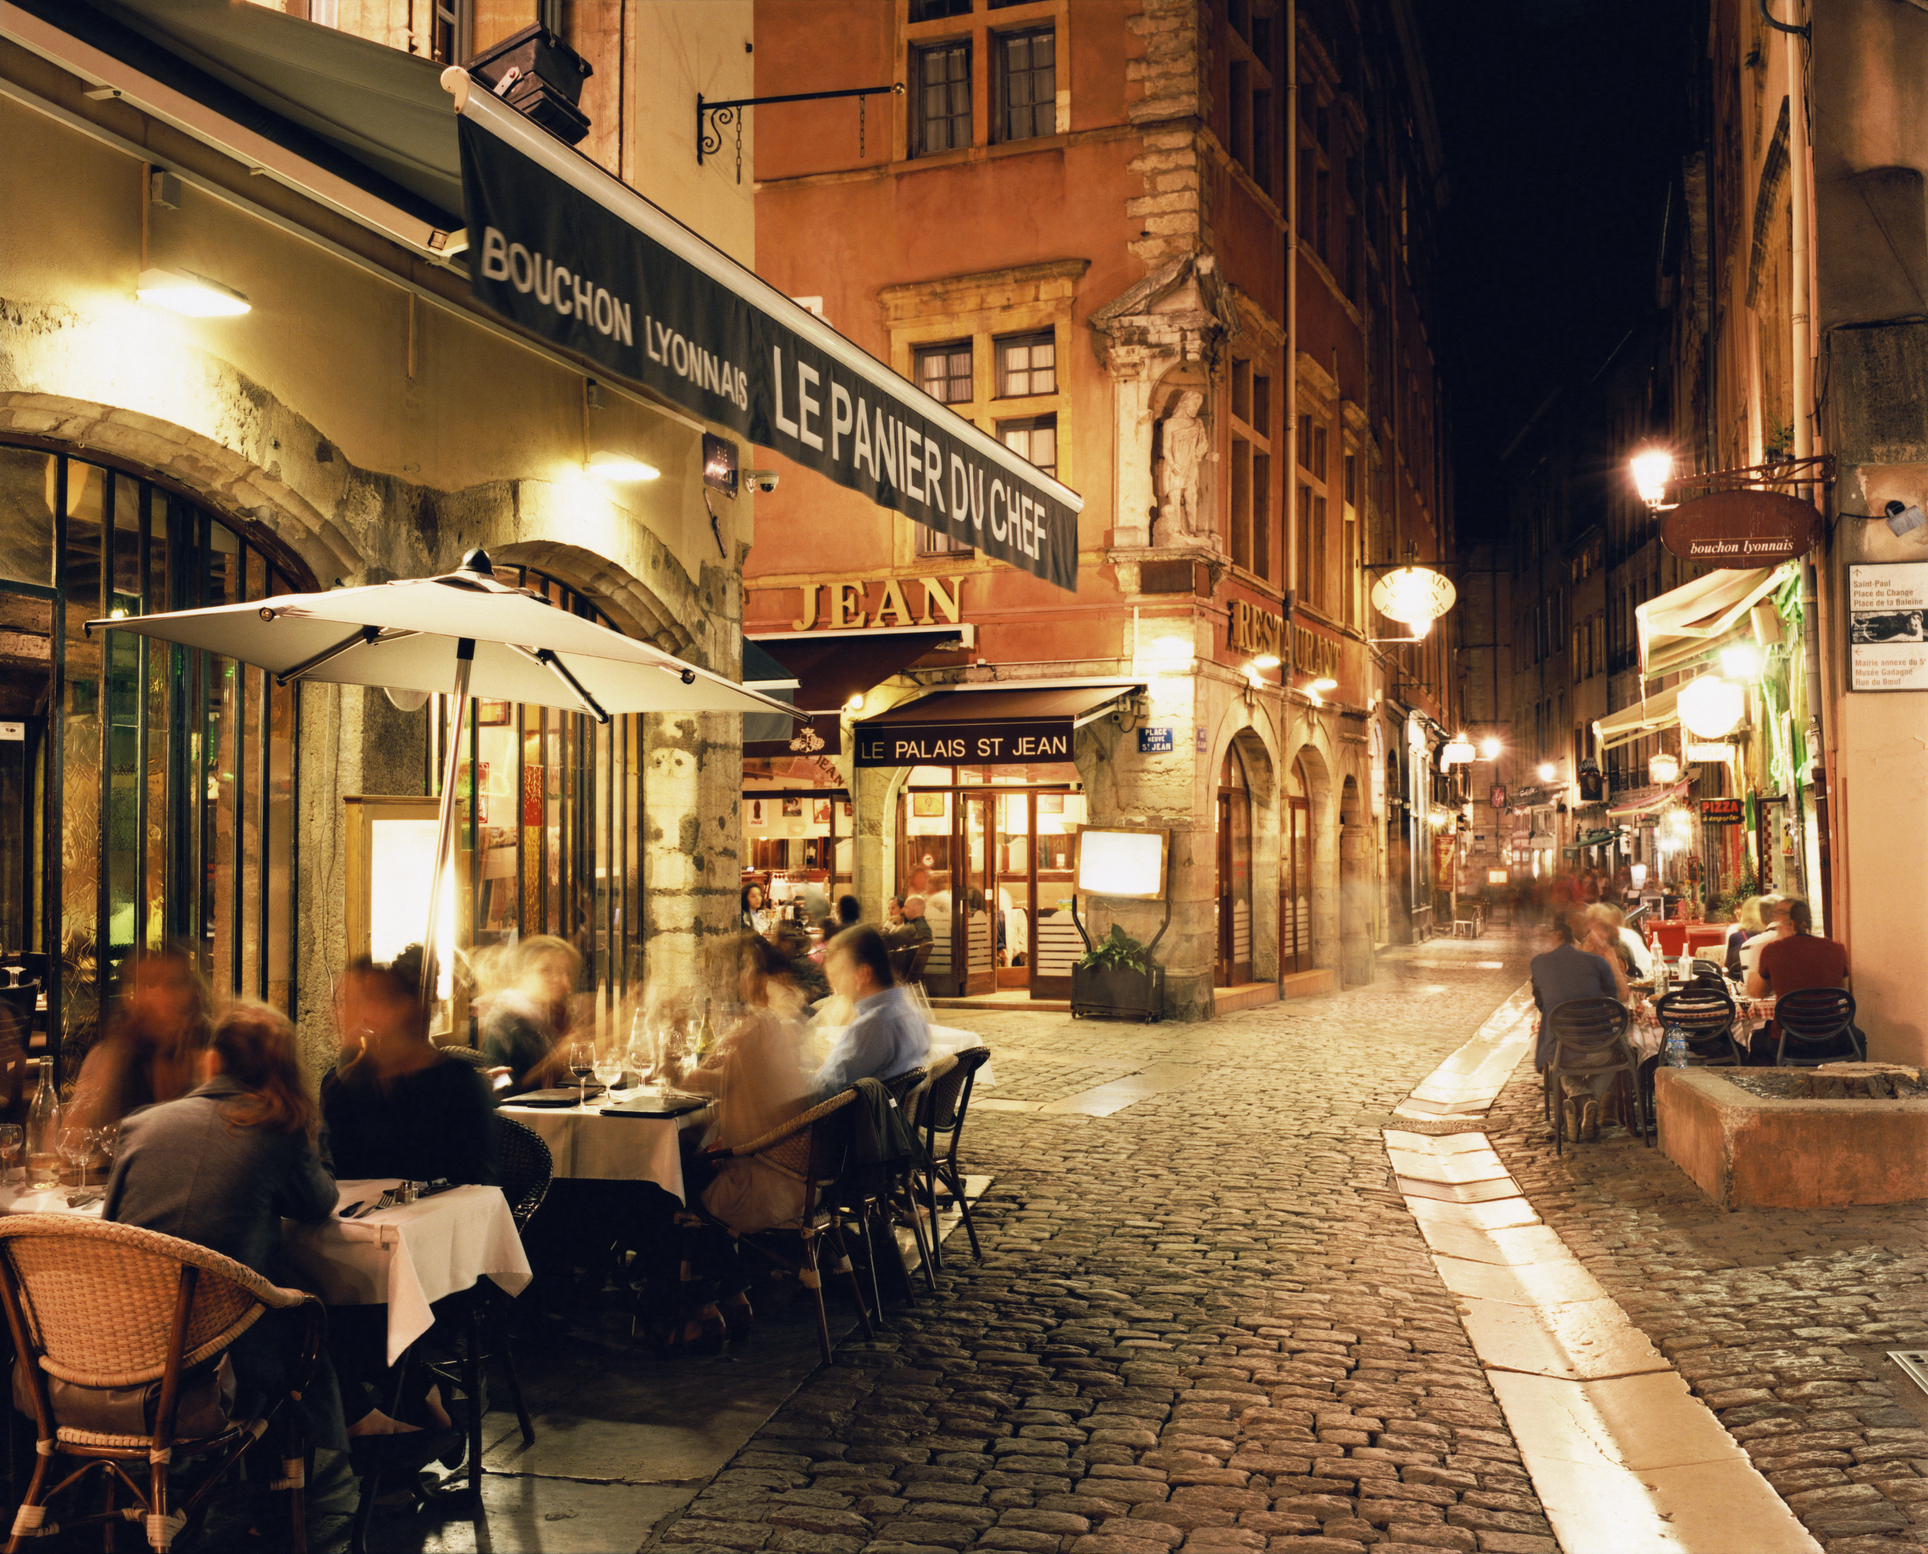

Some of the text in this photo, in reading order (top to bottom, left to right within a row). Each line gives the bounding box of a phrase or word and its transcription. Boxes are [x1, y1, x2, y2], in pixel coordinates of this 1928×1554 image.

[481, 226, 748, 412] BOUCHON LYONNAIS
[773, 345, 1047, 560] LE PANIER DU CHEF
[1690, 538, 1794, 555] bouchon lyonnais
[1853, 579, 1891, 588] Saint-Paul
[1853, 589, 1914, 598] Place du Change
[791, 575, 965, 631] JEAN
[1853, 598, 1924, 607] Place de la Baleine
[1238, 598, 1342, 678] RESTAURANT
[1855, 659, 1879, 667] Mairie
[1908, 658, 1918, 666] du
[1855, 668, 1879, 676] Musée
[1855, 678, 1869, 686] Rue
[1871, 678, 1881, 686] du
[1145, 728, 1168, 736] PLACE
[861, 735, 1067, 760] LE PALAIS ST JEAN
[1151, 742, 1171, 751] JEAN
[1702, 801, 1739, 813] PIZZA
